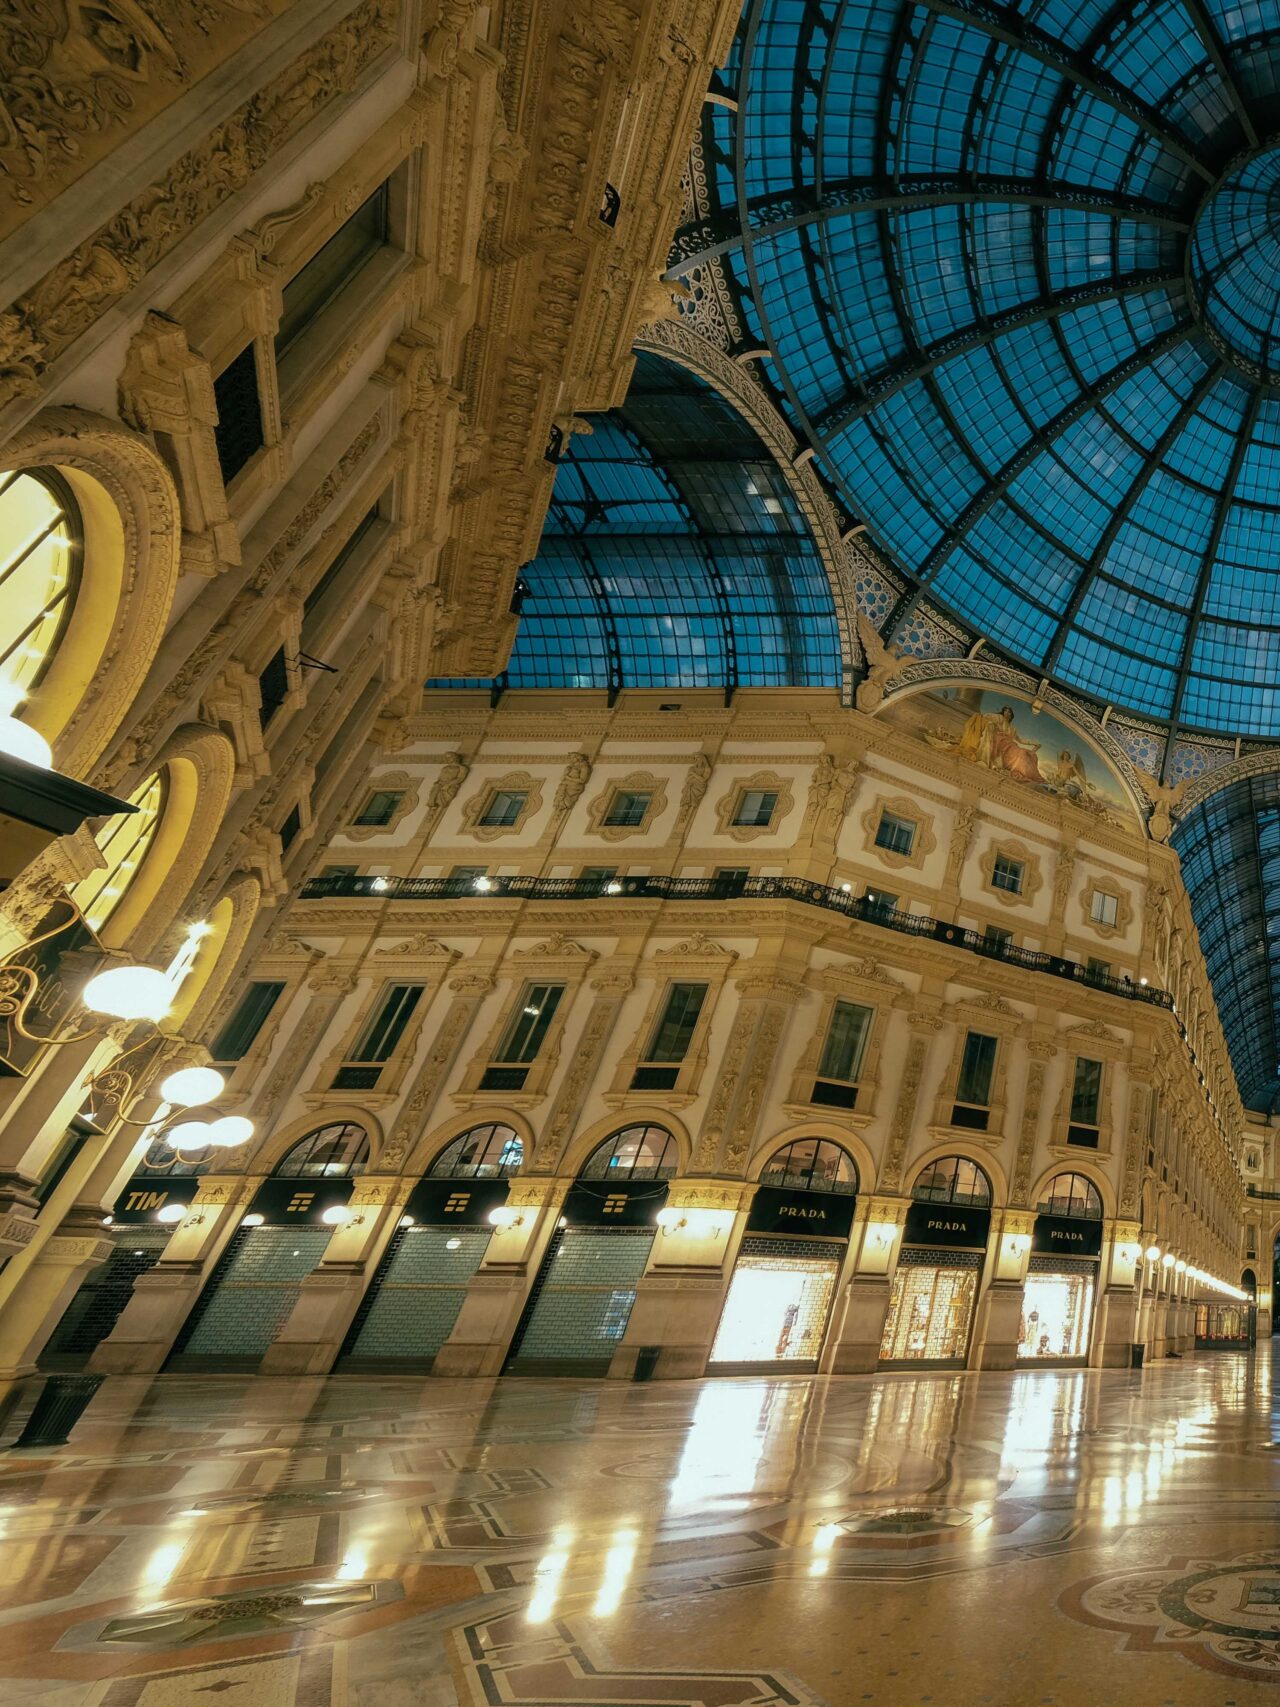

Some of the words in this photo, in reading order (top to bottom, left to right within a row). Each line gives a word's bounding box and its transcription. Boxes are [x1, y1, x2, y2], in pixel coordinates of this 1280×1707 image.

[125, 1192, 169, 1211] TIM
[779, 1206, 826, 1219] PRADA
[928, 1220, 967, 1232] PRADA
[1051, 1230, 1084, 1241] PRADA
